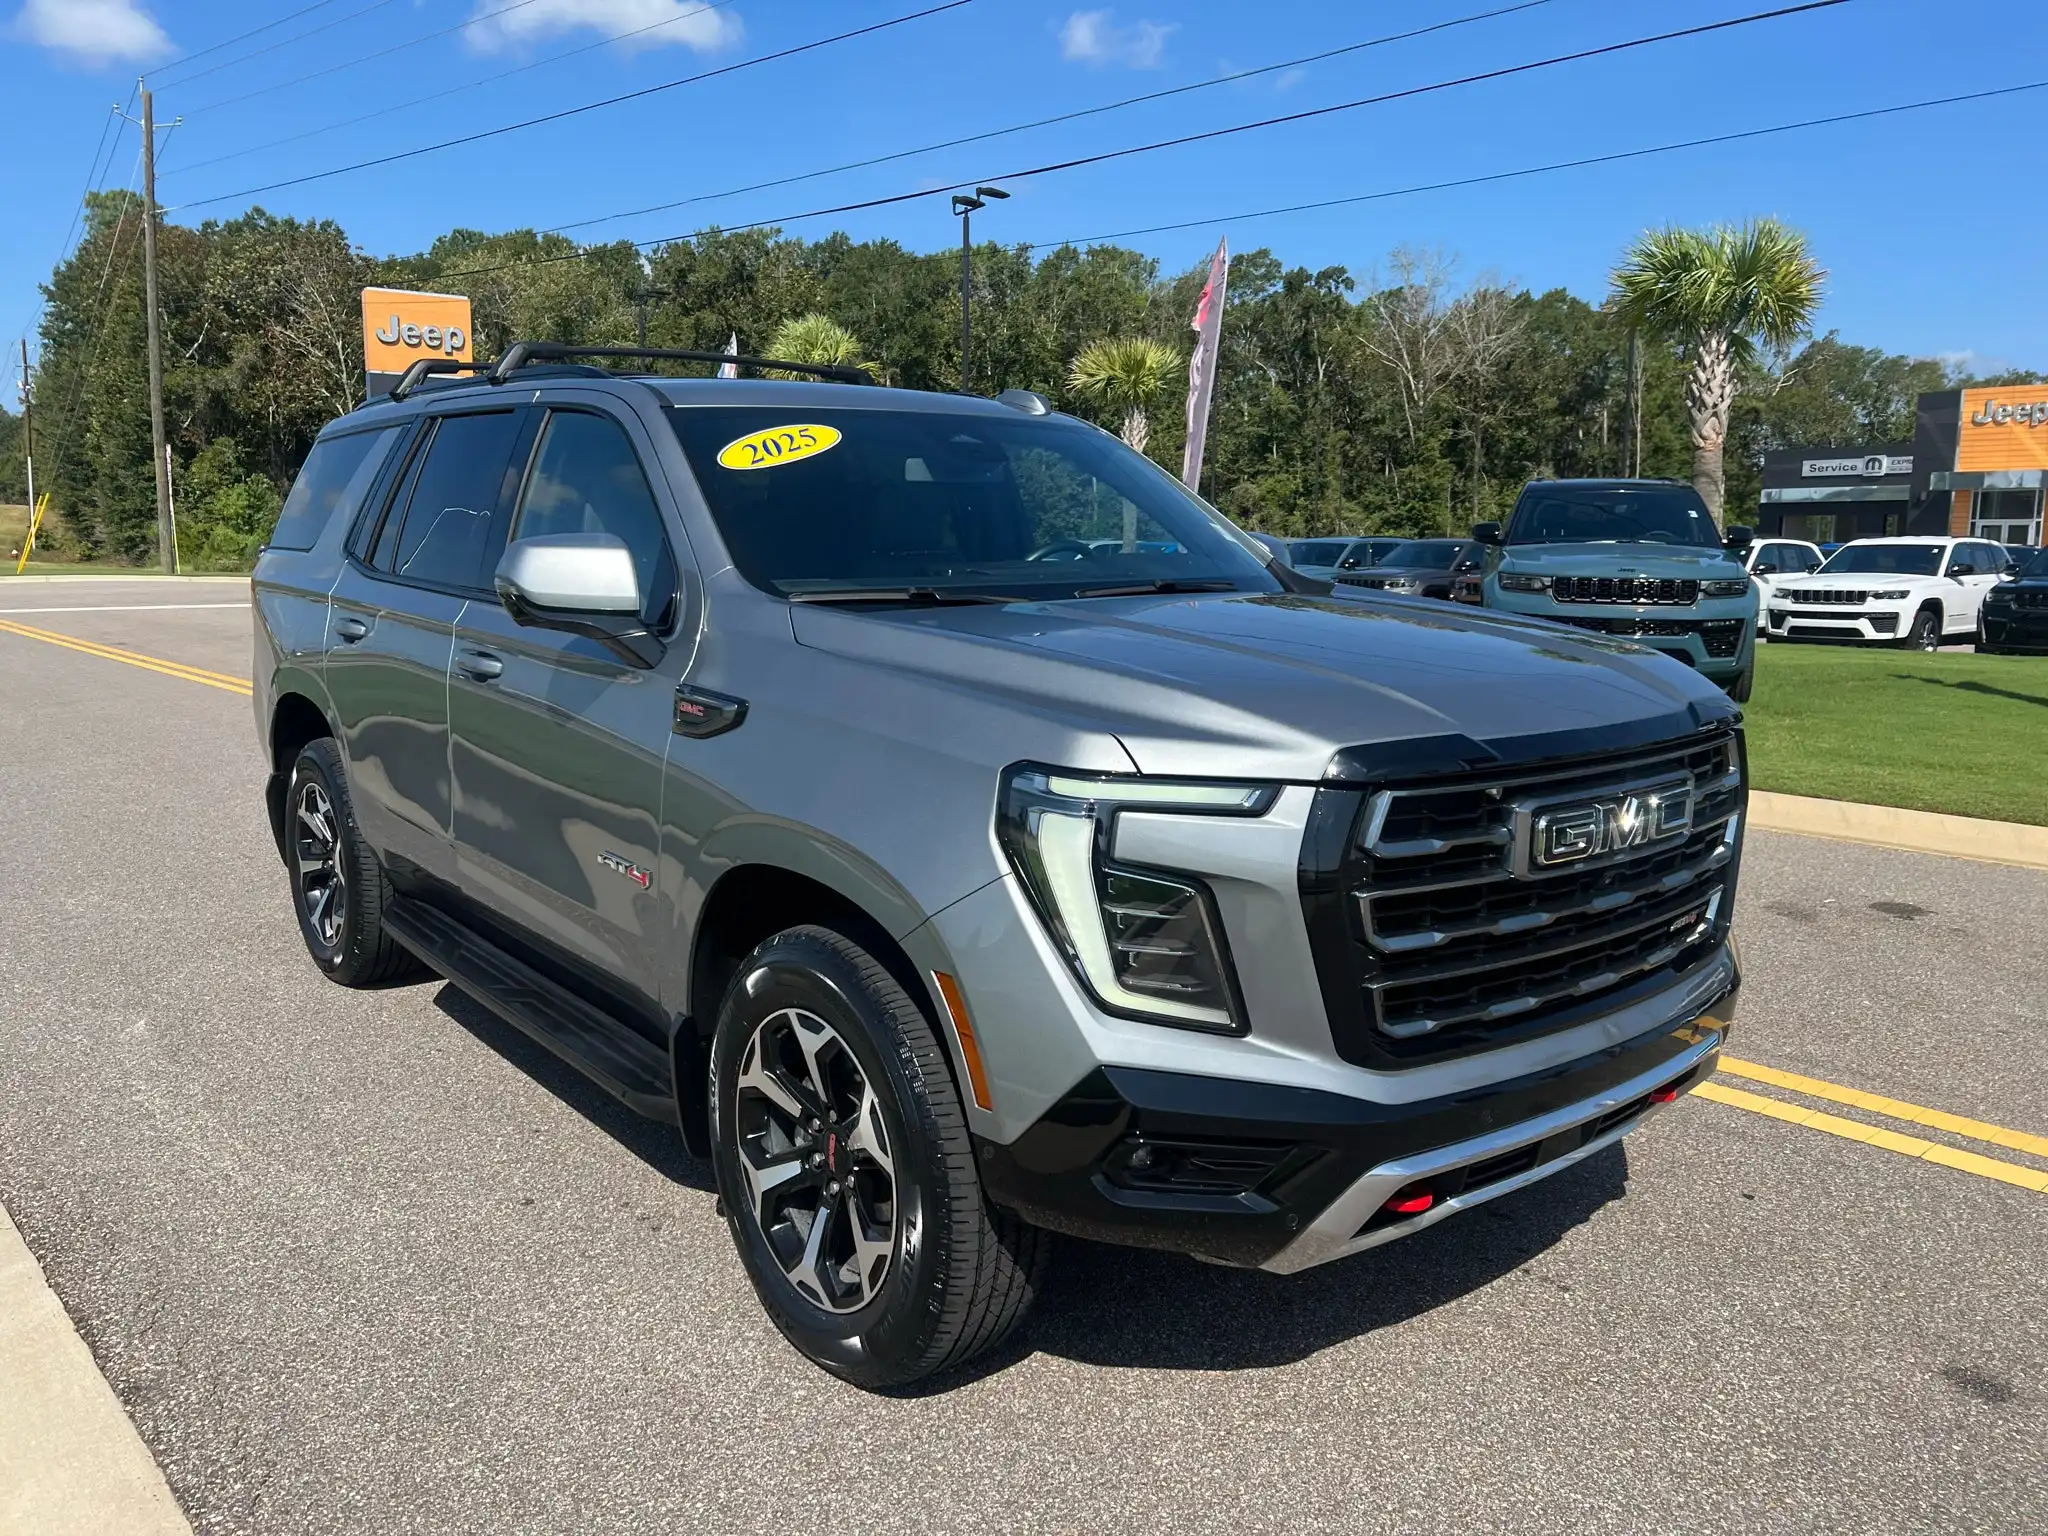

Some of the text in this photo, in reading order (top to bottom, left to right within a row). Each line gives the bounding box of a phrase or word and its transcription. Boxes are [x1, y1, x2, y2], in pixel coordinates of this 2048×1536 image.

[375, 314, 465, 355] Jeep
[1972, 399, 2048, 428] Jeep
[741, 427, 817, 466] 2025
[1808, 462, 1858, 473] Service
[679, 700, 705, 717] GMC
[1532, 785, 1694, 867] GMC
